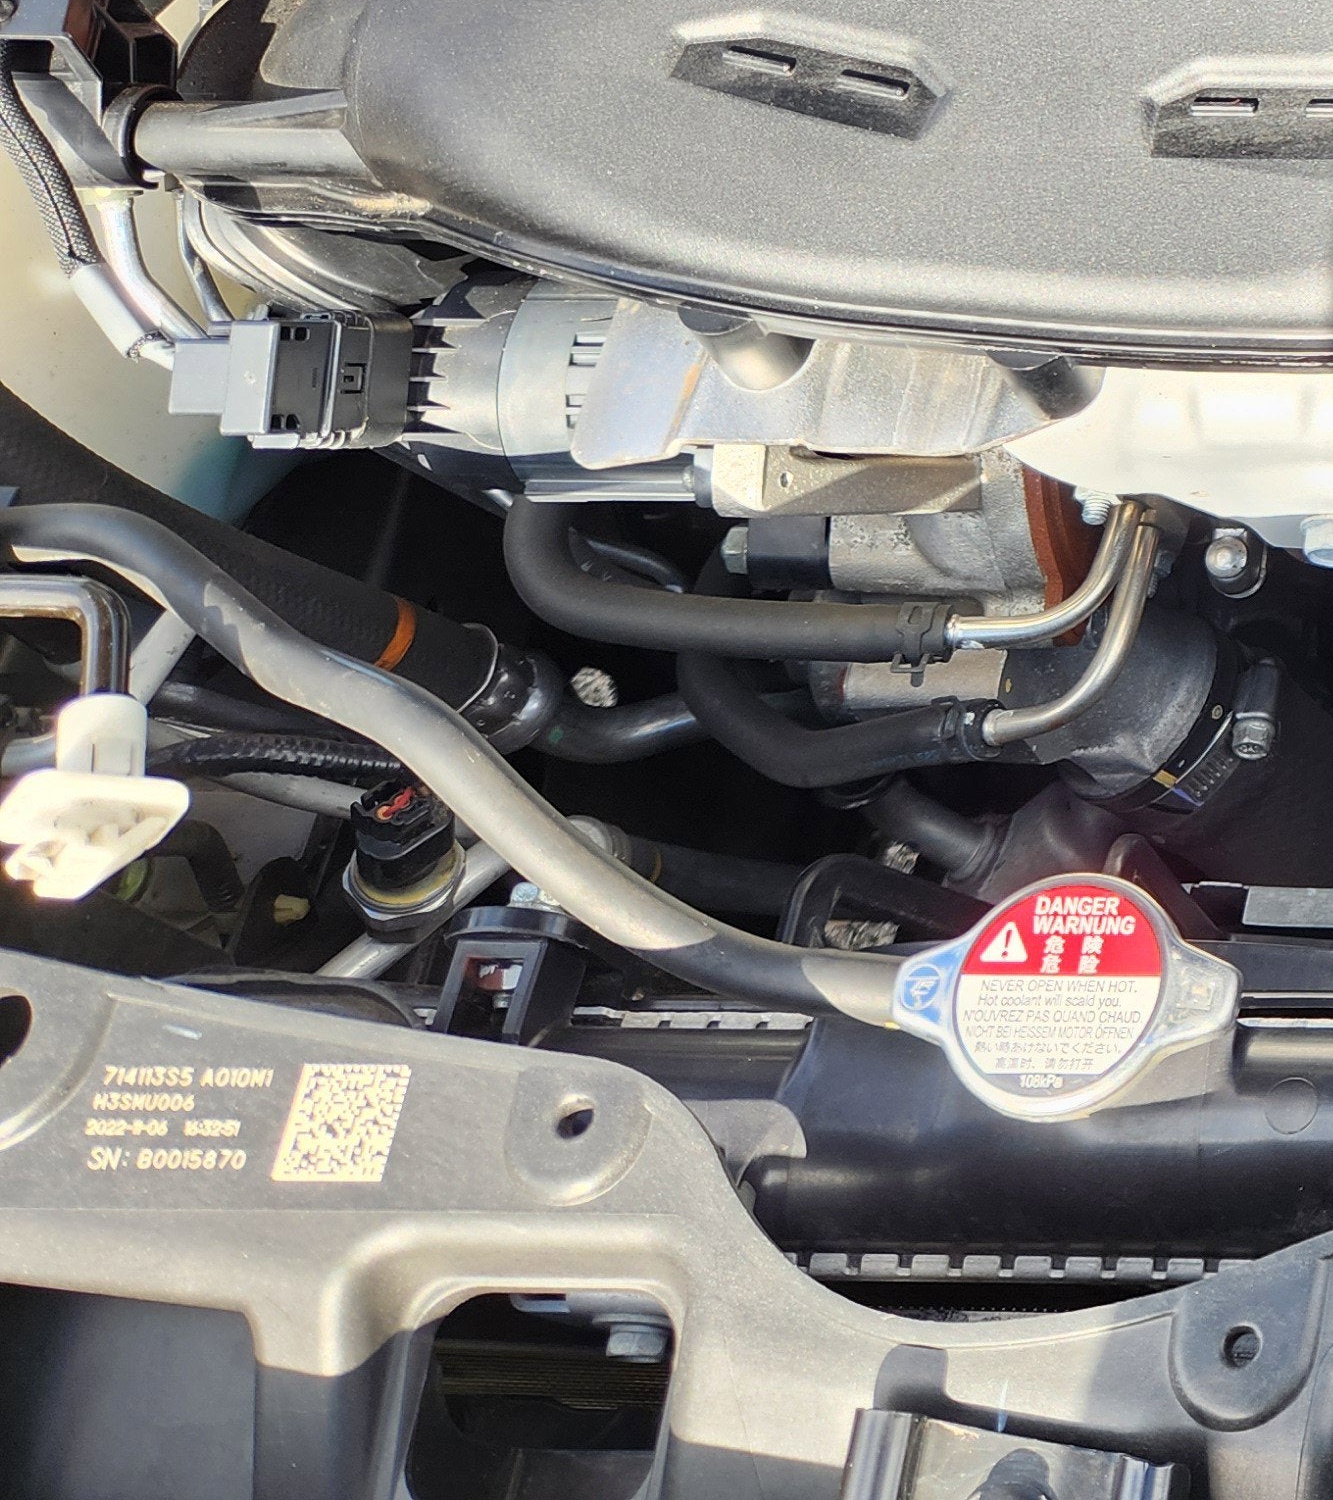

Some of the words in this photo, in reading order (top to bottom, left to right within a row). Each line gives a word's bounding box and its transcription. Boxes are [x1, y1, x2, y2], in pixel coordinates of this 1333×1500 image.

[1035, 896, 1120, 916] DANGER
[1033, 915, 1136, 935] WARNUNG
[981, 980, 1024, 991] NEVER
[1027, 980, 1063, 991] OPEN
[1067, 980, 1105, 992] WHEN
[1108, 980, 1138, 992] HOT.
[977, 993, 998, 1006] Hot
[1001, 994, 1042, 1006] coolant
[1045, 994, 1063, 1006] will
[1065, 994, 1095, 1006] scald
[1098, 997, 1122, 1010] you.
[963, 1010, 1024, 1022] N'OUVREZ
[1026, 1010, 1050, 1022] PAS
[1053, 1010, 1096, 1023] QUAND
[965, 1026, 995, 1038] NICHT
[1057, 1027, 1094, 1038] MOTOR
[1020, 1074, 1064, 1089] 108kPa
[87, 1145, 131, 1171] SN:
